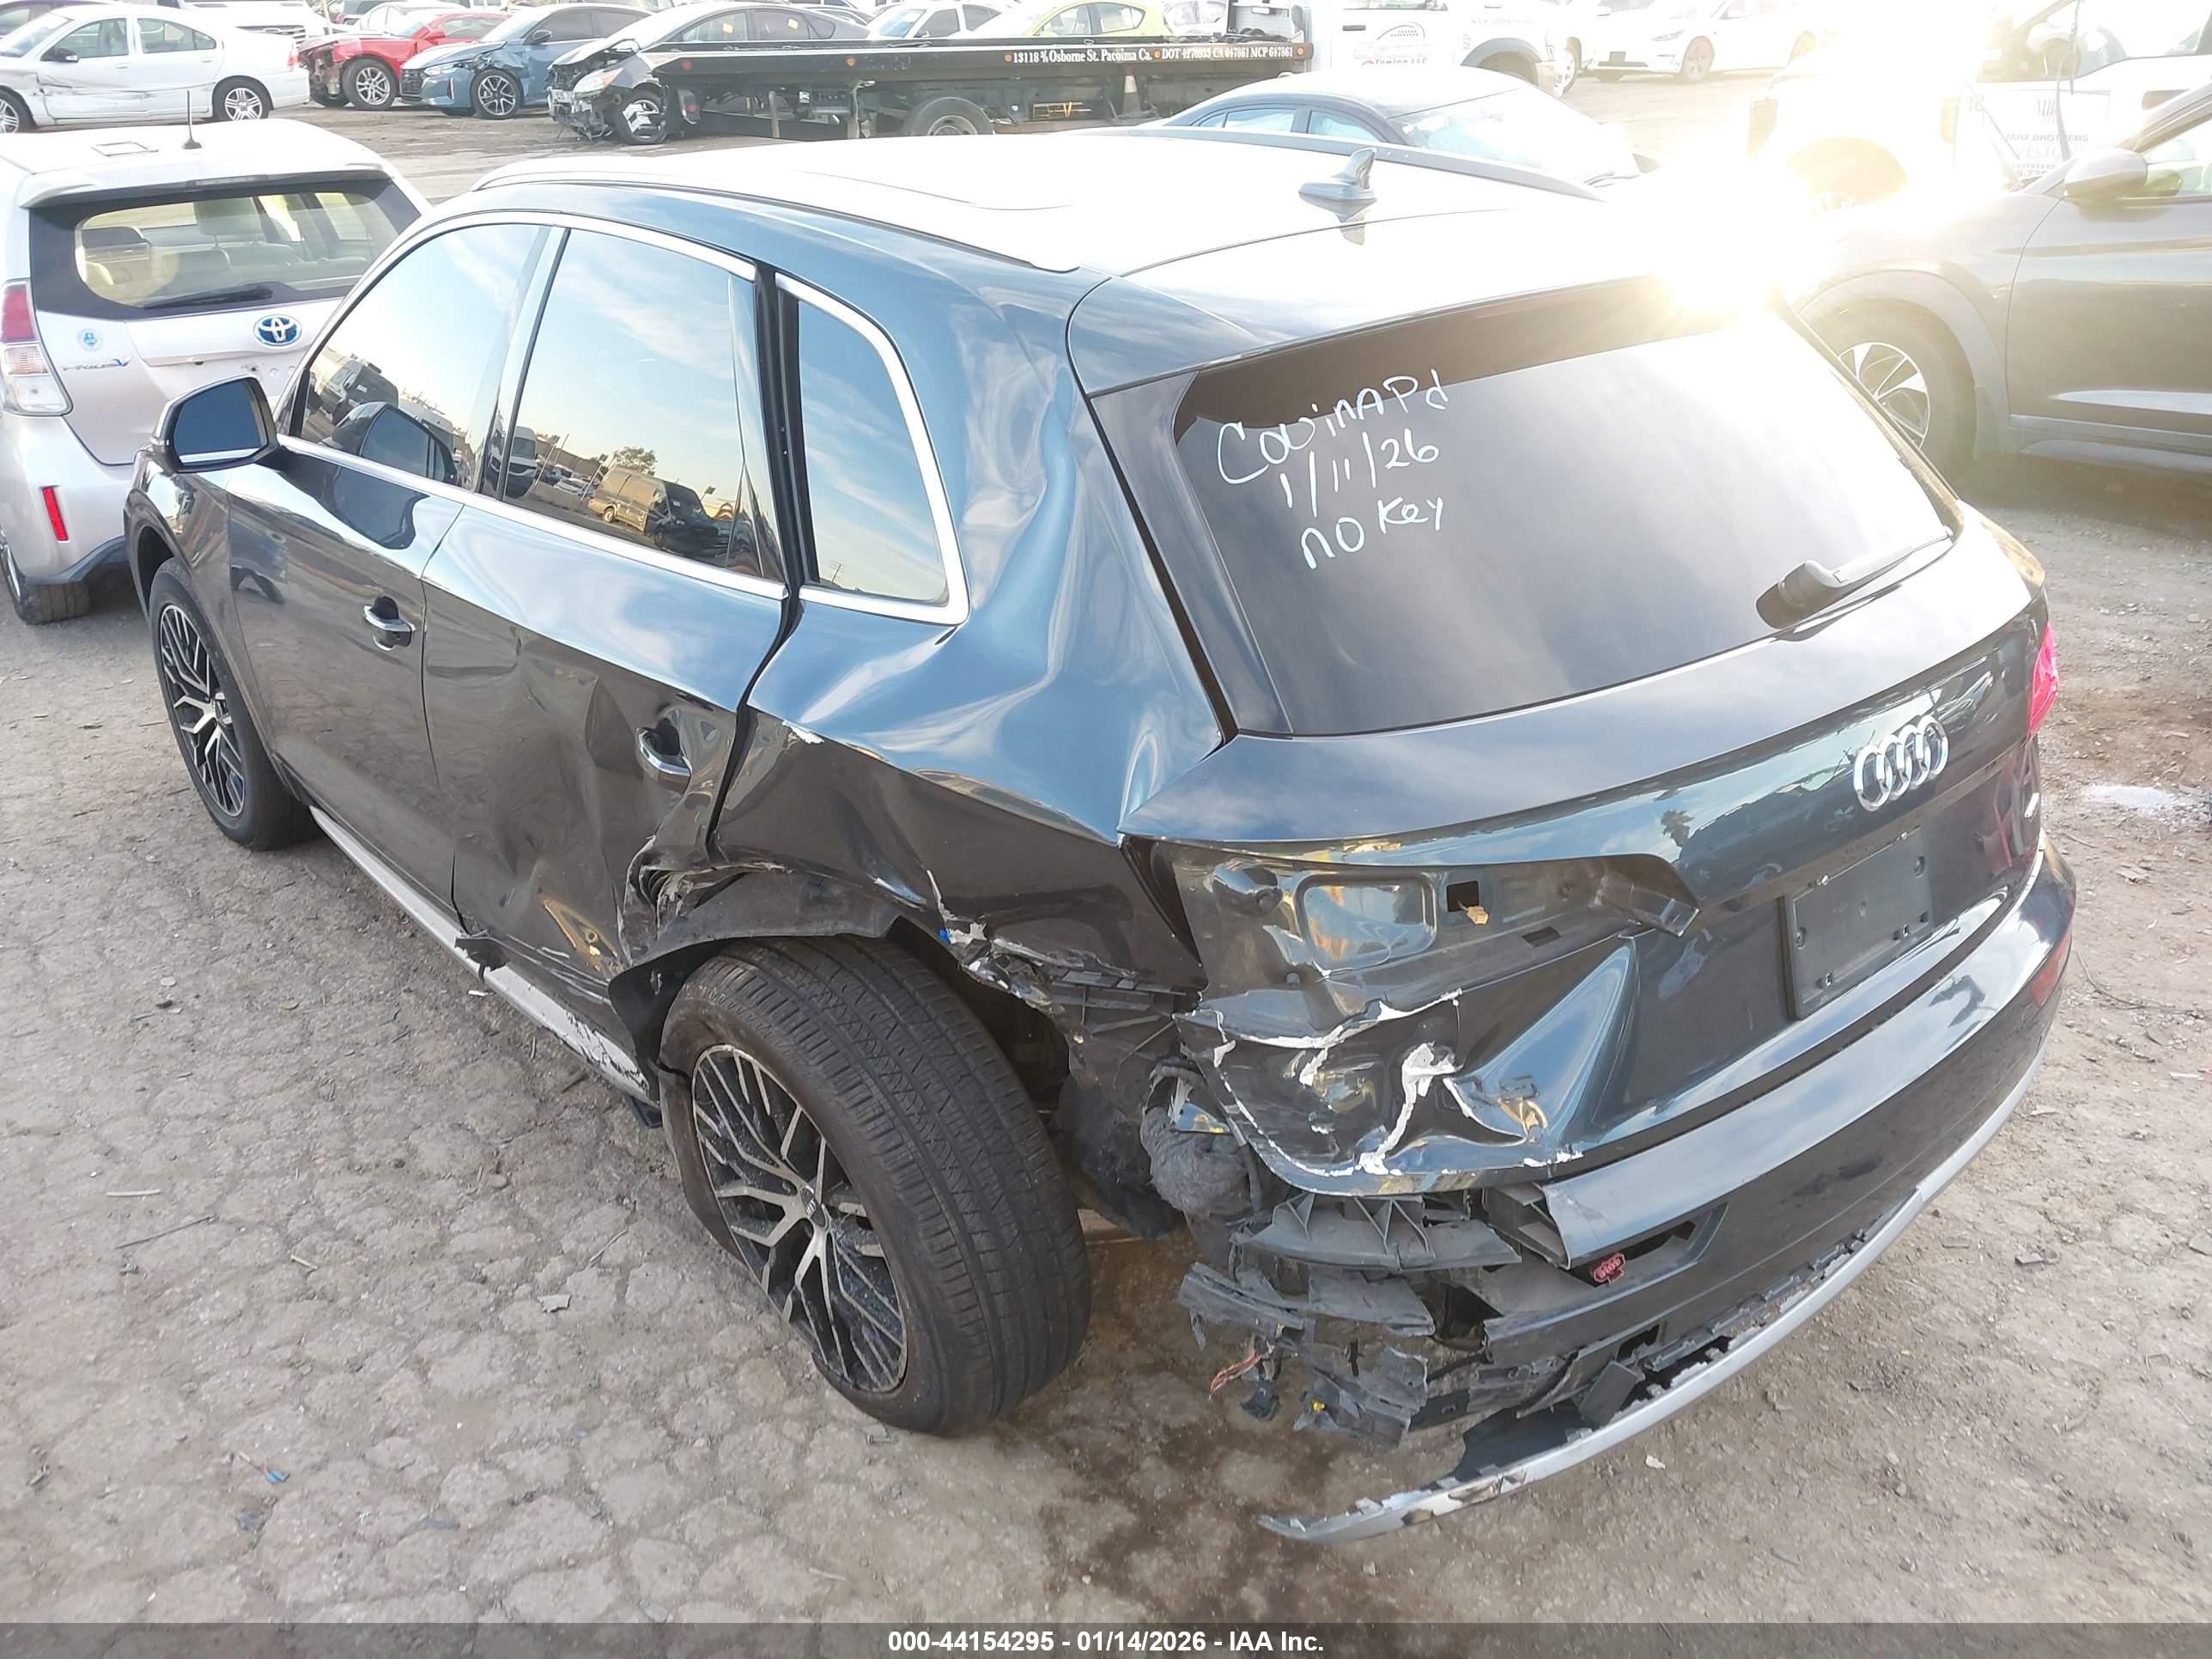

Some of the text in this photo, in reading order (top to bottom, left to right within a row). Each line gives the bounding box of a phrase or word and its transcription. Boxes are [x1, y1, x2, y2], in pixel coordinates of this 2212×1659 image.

[1048, 49, 1085, 62] Osborne
[1086, 48, 1099, 62] St.
[1101, 48, 1138, 62] Pacoima
[1139, 47, 1152, 61] Ca.
[1162, 47, 1181, 59] DOT
[2033, 134, 2089, 143] BROTERS
